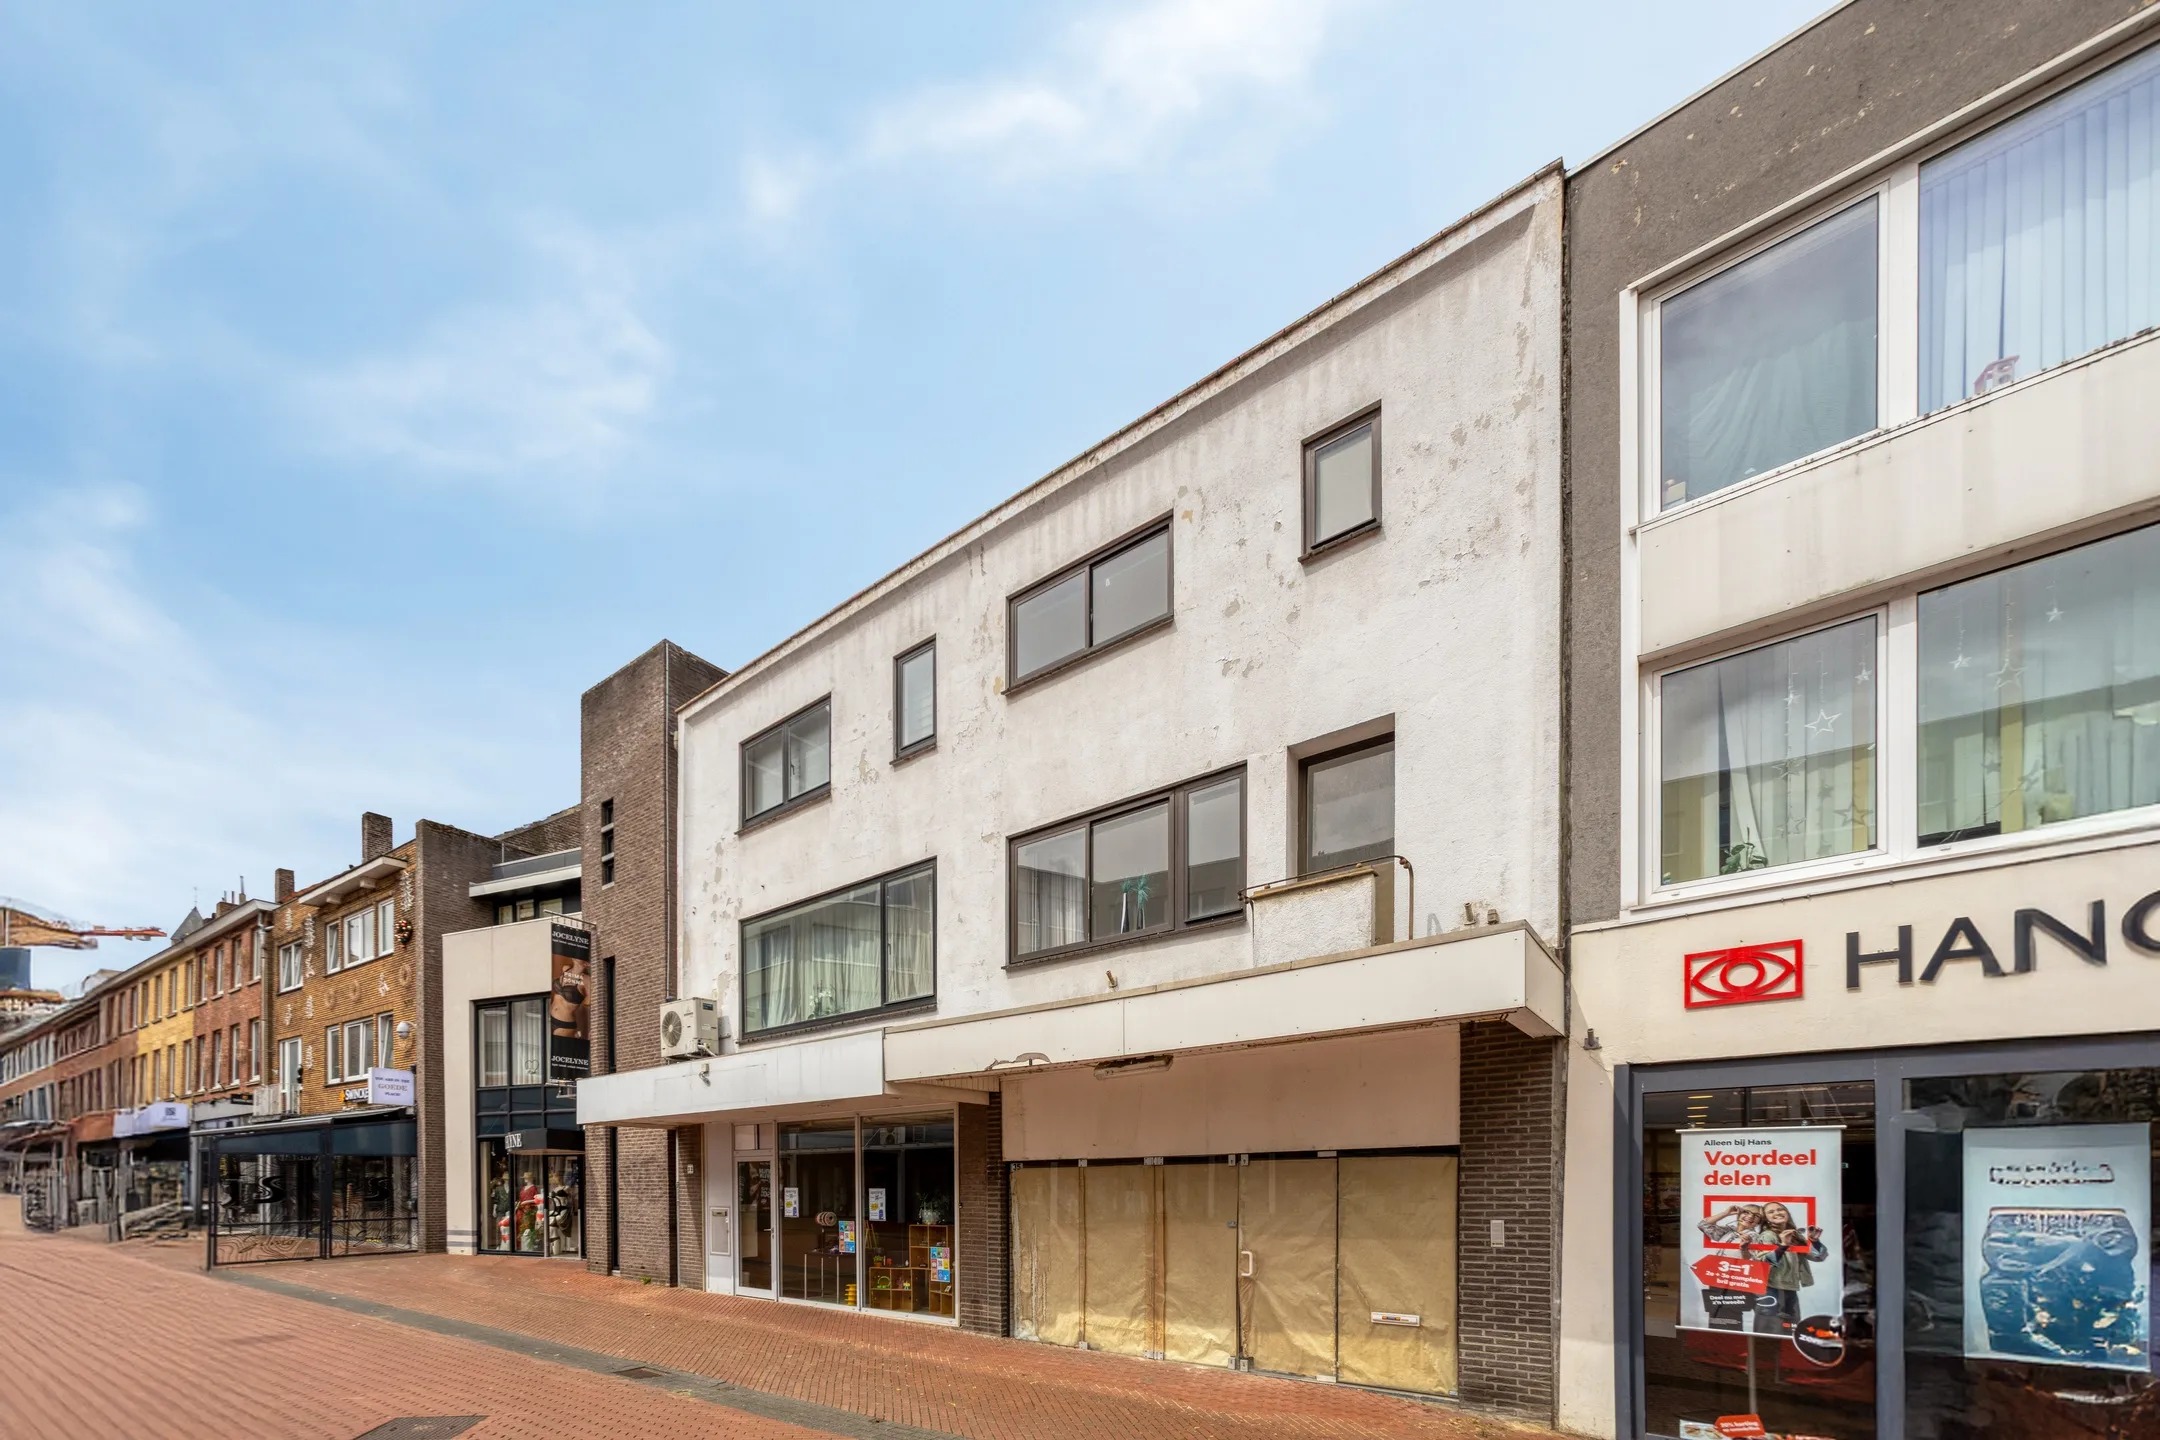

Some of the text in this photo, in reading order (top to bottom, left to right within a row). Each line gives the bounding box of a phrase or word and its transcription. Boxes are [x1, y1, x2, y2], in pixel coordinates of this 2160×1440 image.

[551, 930, 589, 944] JOCELYNE
[563, 971, 584, 980] PRIMA
[562, 977, 585, 986] DONNA
[551, 1055, 589, 1066] JOCELYNE
[378, 1083, 408, 1092] GOEDE
[1734, 1139, 1746, 1147] bij
[1748, 1138, 1772, 1146] Hans
[1704, 1149, 1817, 1166] Voordeel
[1703, 1170, 1772, 1186] delen
